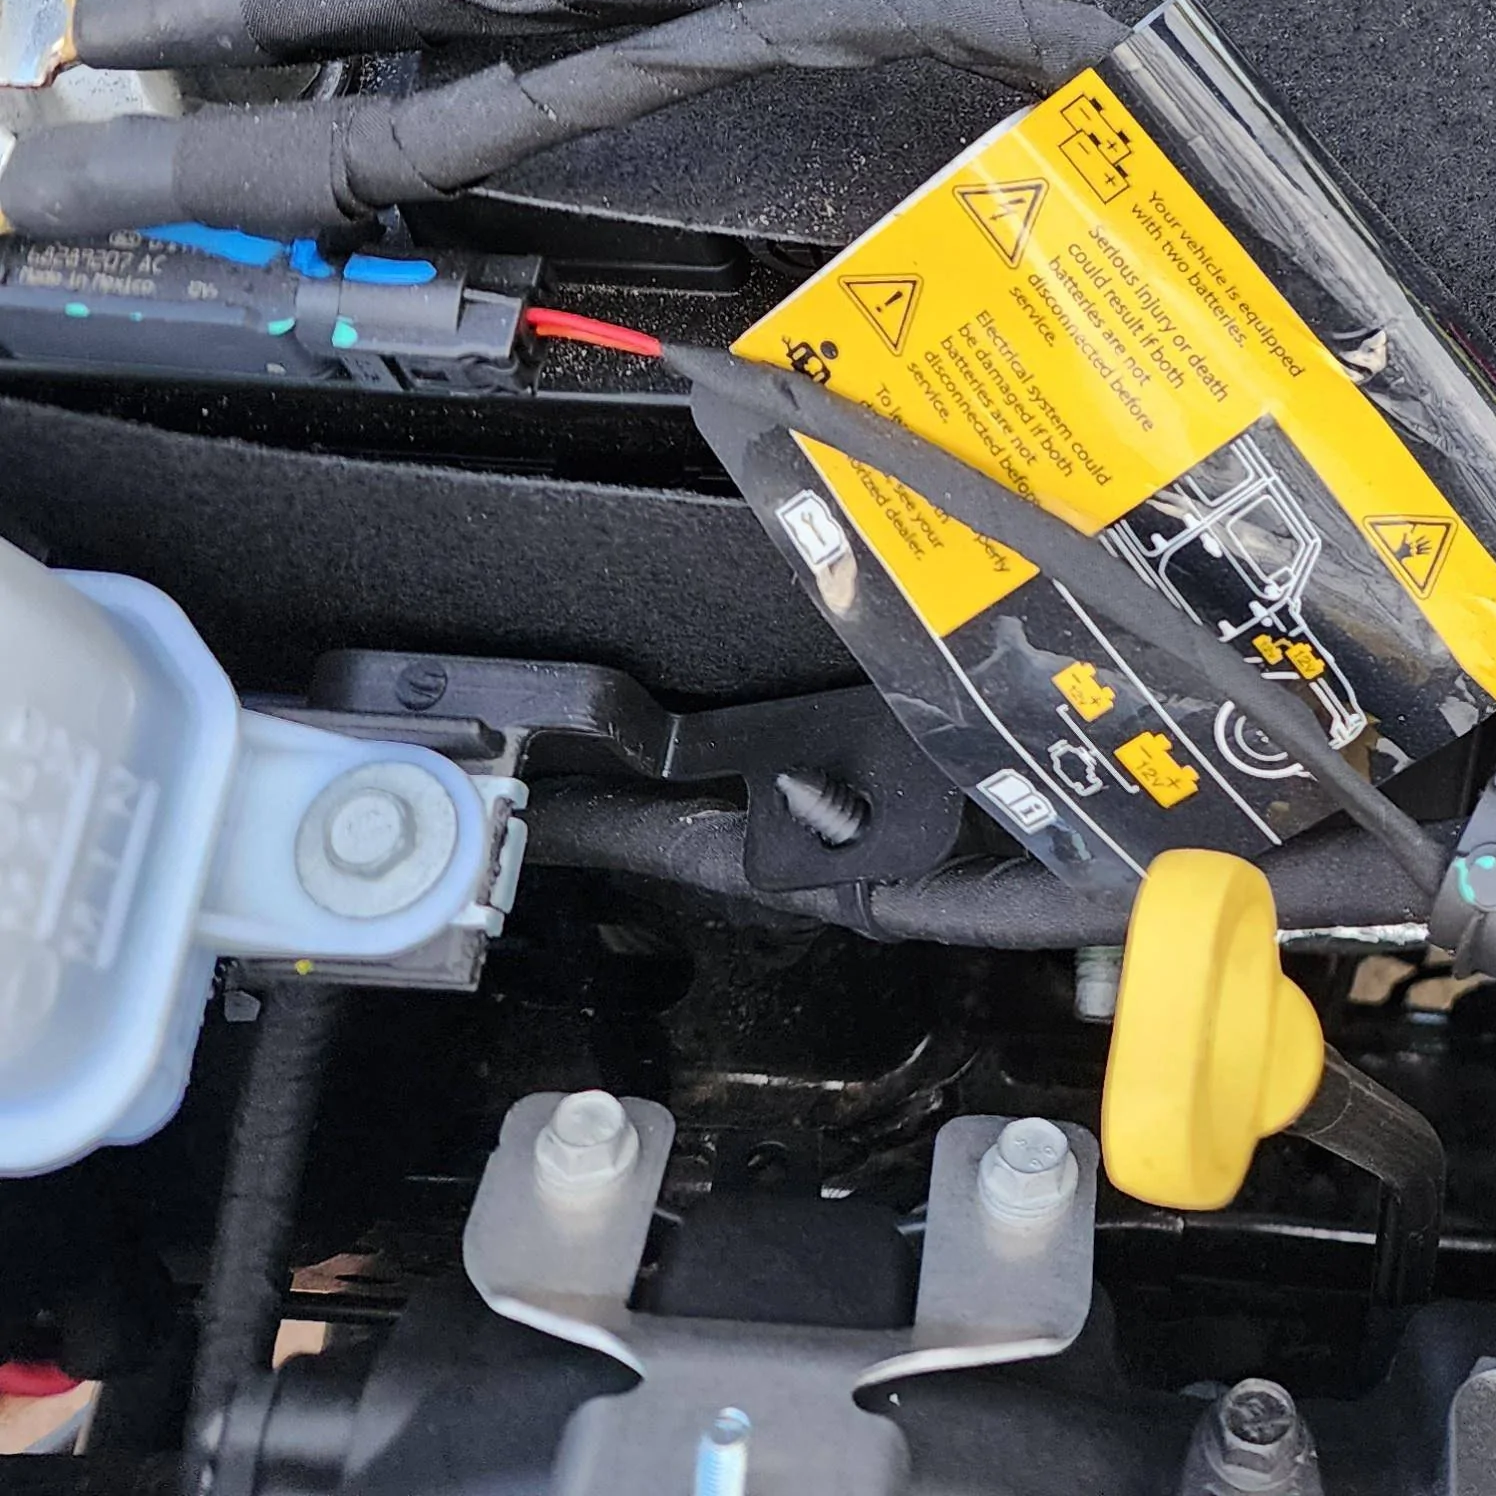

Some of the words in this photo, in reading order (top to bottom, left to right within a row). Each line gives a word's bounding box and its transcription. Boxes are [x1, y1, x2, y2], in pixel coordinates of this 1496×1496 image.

[1009, 287, 1055, 347] service.
[1049, 256, 1104, 328] batteries
[1102, 329, 1126, 354] are
[1124, 356, 1151, 387] not
[1068, 244, 1112, 289] could
[1104, 289, 1144, 336] result
[1138, 332, 1159, 348] if
[1150, 346, 1184, 389] both
[1087, 224, 1139, 286] Serious
[1134, 283, 1176, 332] injury
[1172, 335, 1192, 352] or
[1188, 354, 1228, 402] death
[1132, 204, 1162, 240] with
[1162, 240, 1189, 273] two
[1187, 272, 1247, 347] batteries.
[1149, 191, 1181, 227] Your
[1180, 230, 1225, 284] vehicle
[1225, 284, 1240, 301] is
[1238, 302, 1305, 377] equipped
[876, 384, 892, 407] To
[907, 363, 949, 423] service.
[925, 351, 1005, 456] disconnected
[941, 336, 993, 407] batteries
[990, 409, 1014, 434] are
[1010, 436, 1037, 466] not
[958, 323, 977, 348] be
[975, 349, 1035, 424] damaged
[1029, 422, 1048, 438] if
[1040, 436, 1073, 477] both
[976, 310, 1034, 384] Electrical
[1026, 384, 1072, 440] system
[1071, 442, 1111, 486] could
[1028, 274, 1114, 378] disconnected
[1110, 377, 1153, 431] before
[886, 509, 925, 560] dealer.
[911, 512, 944, 547] your
